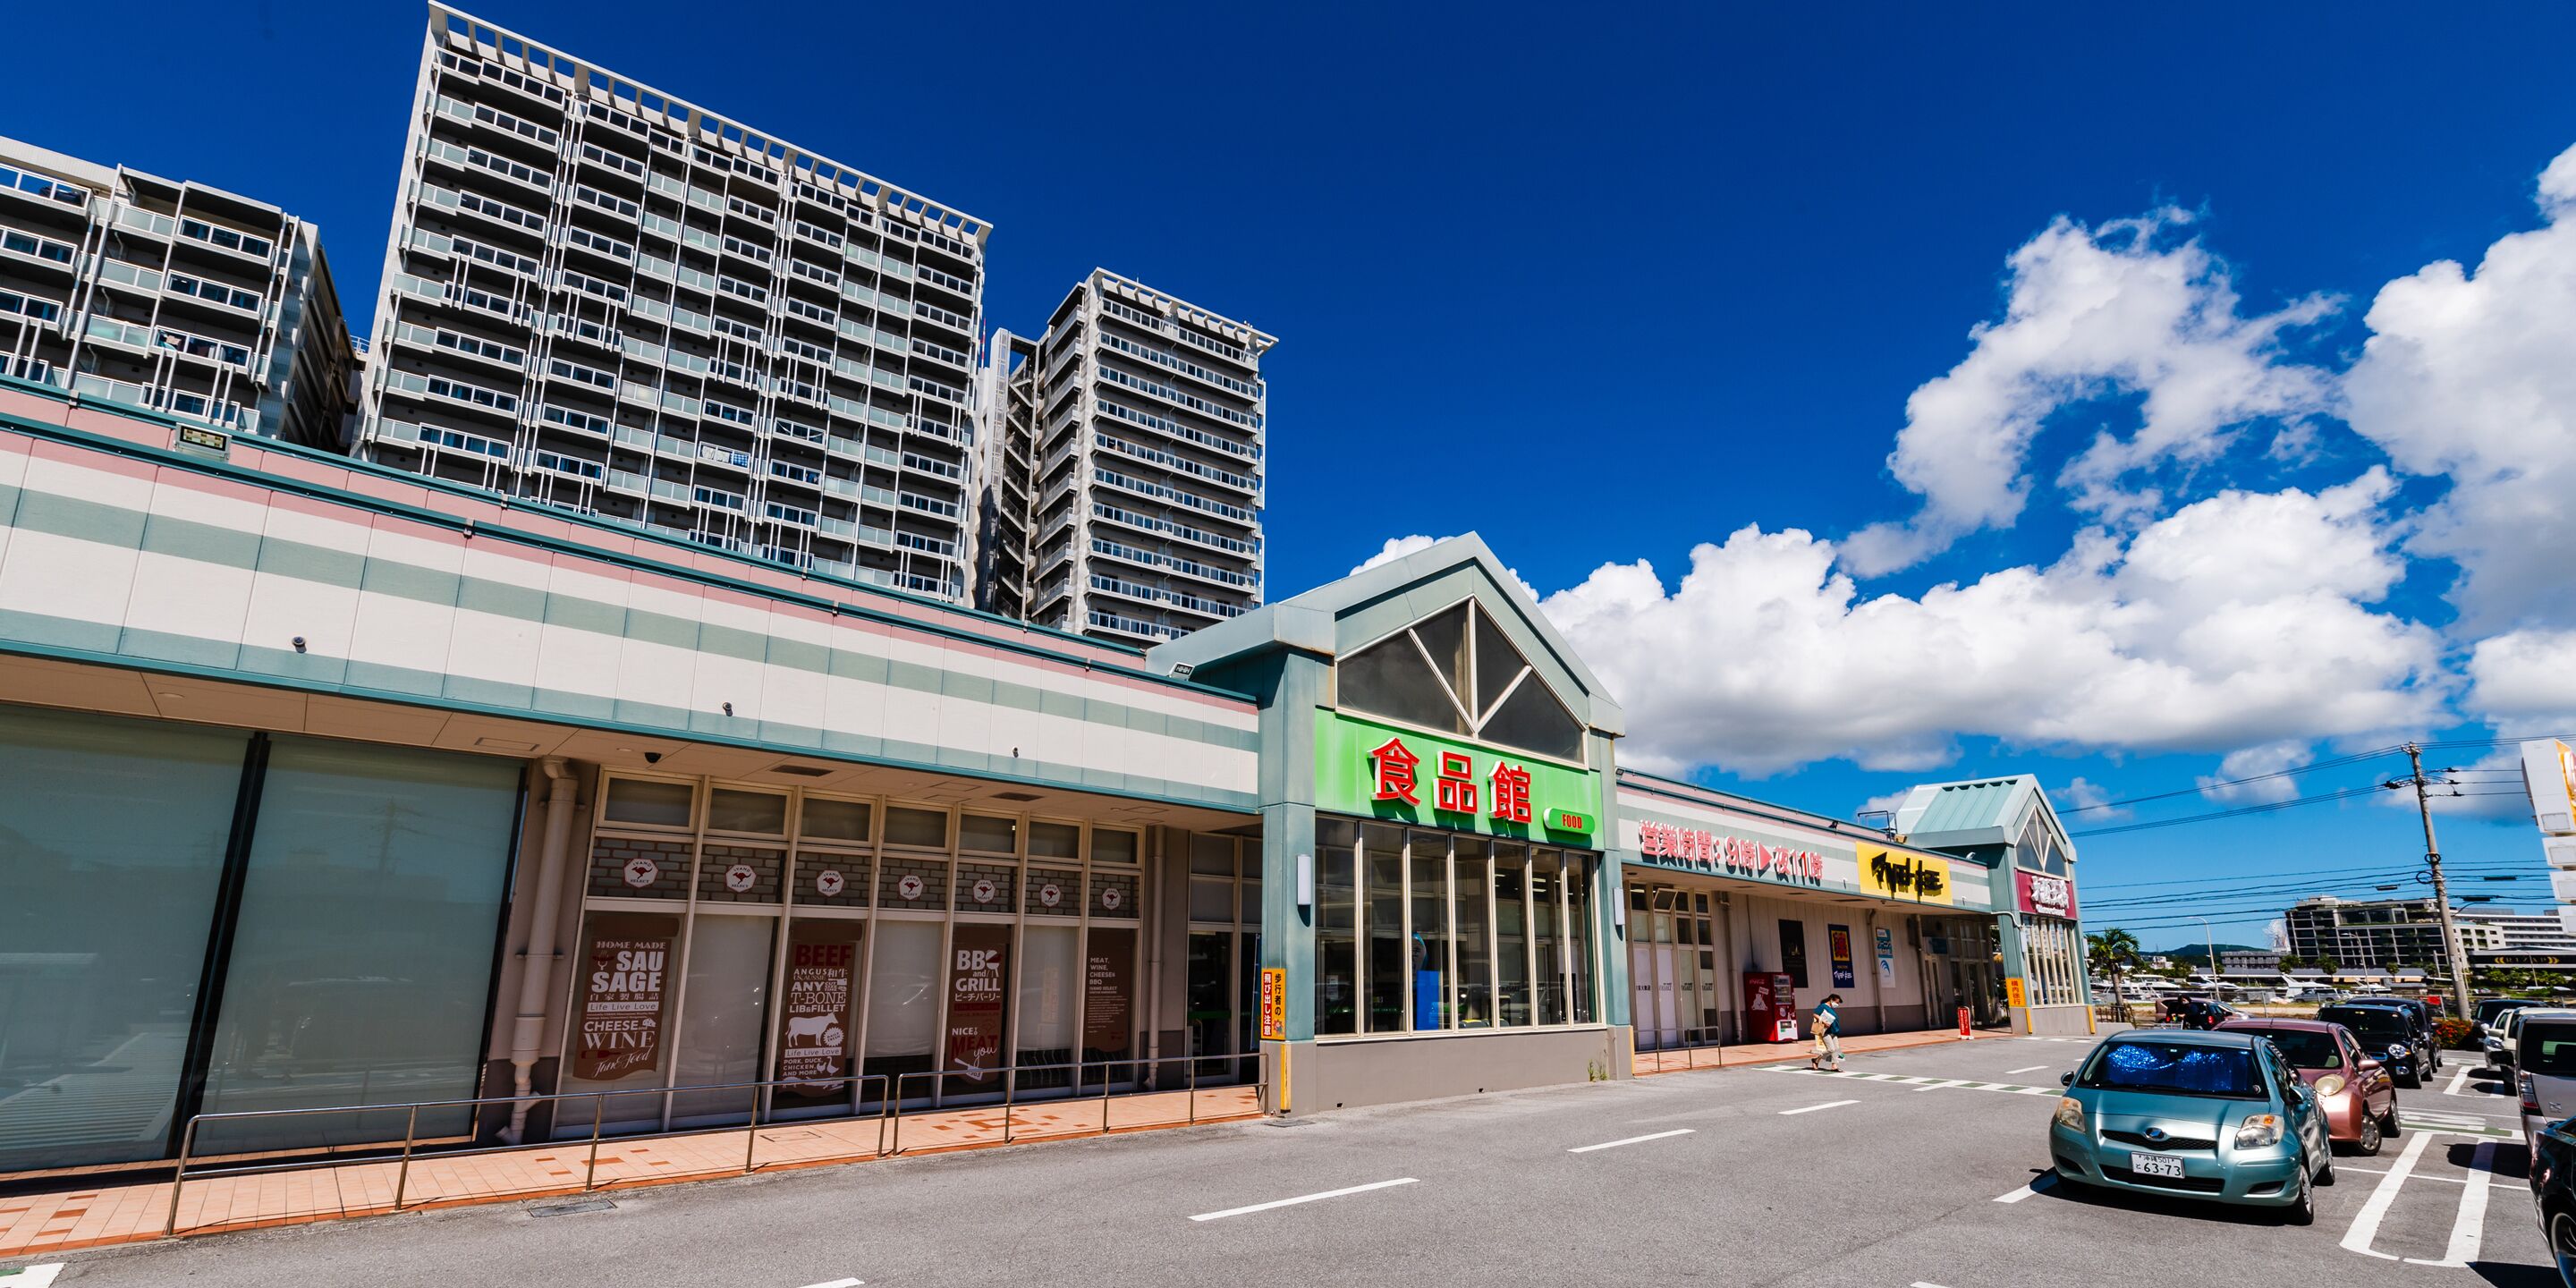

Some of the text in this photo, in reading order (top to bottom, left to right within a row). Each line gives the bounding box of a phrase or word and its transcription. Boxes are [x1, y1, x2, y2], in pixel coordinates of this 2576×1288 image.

[1367, 737, 1532, 824] 食品館
[1562, 813, 1582, 829] FOOD
[597, 941, 666, 950] HOME MADE
[616, 951, 665, 972] SAU
[795, 945, 852, 967] BEEF
[973, 970, 987, 978] and
[591, 971, 662, 993] SAGE
[792, 981, 825, 991] ANY
[955, 978, 1001, 992] GRILL
[791, 991, 846, 1004] T-BONE
[634, 1002, 657, 1010] Love
[584, 1020, 639, 1031] CHEESE
[583, 1030, 655, 1050] WINE
[2144, 1163, 2182, 1176] 63-73
